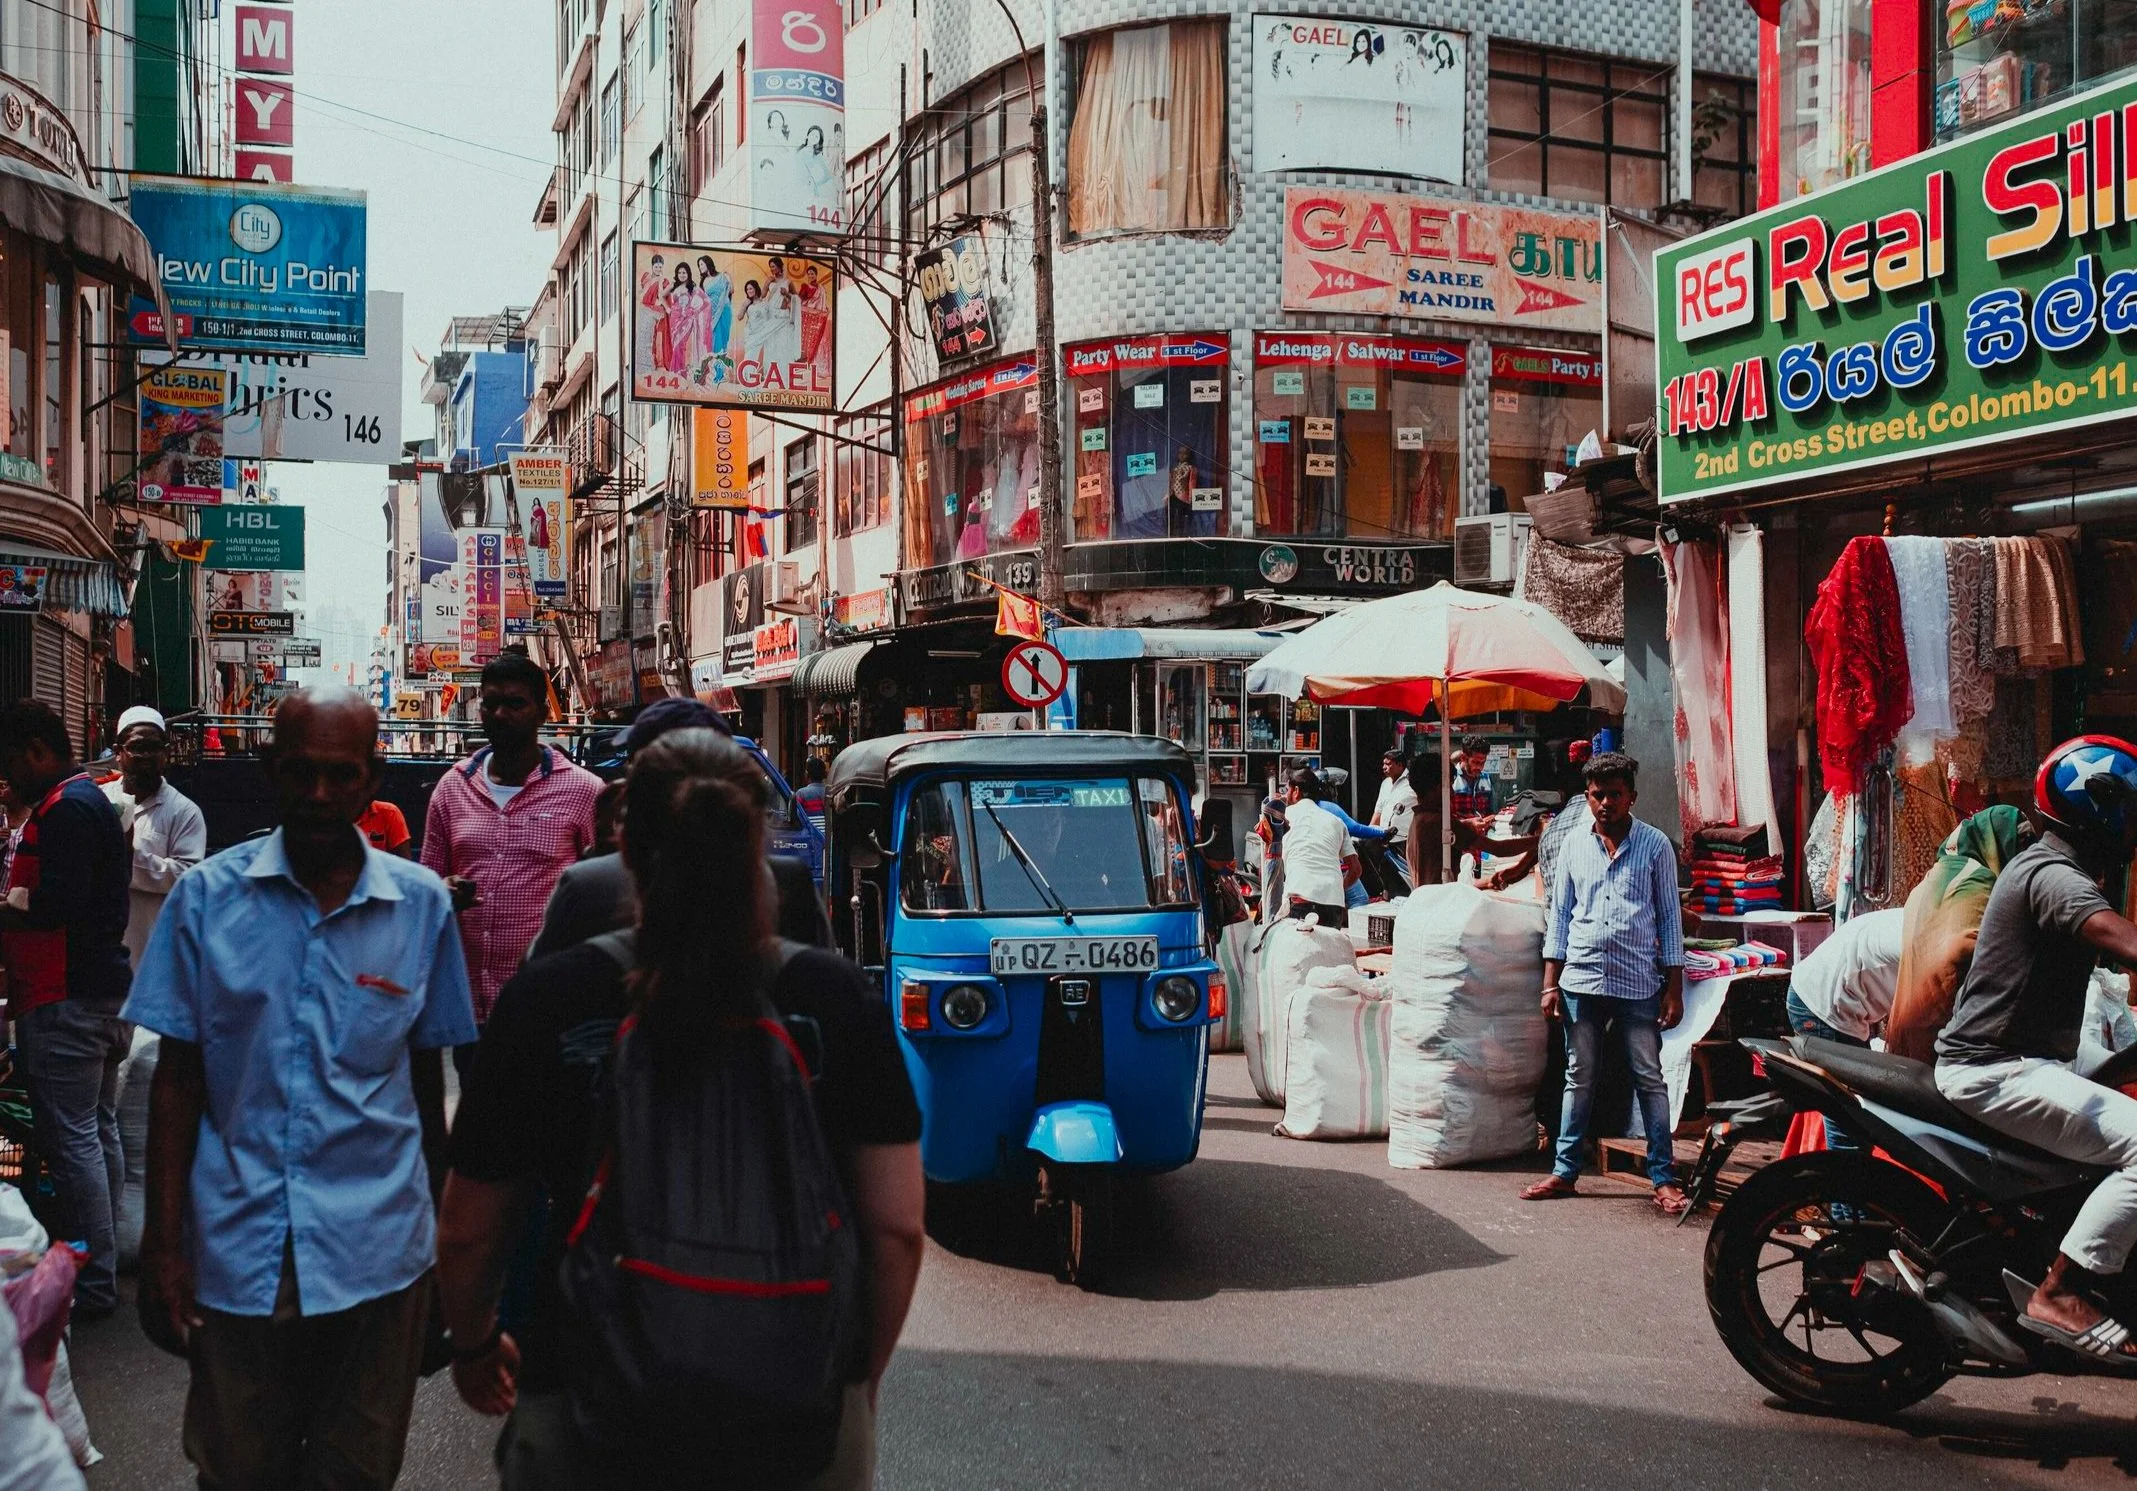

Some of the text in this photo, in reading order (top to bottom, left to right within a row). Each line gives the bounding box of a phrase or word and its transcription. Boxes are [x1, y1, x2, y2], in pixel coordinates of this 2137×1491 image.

[1293, 25, 1348, 47] GAEL
[807, 205, 841, 229] 144
[1769, 103, 2137, 323] Real Sil
[240, 211, 270, 240] City
[1291, 198, 1496, 265] GAEL
[220, 257, 278, 293] City
[287, 262, 361, 293] Point
[1324, 273, 1355, 290] 144
[1406, 268, 1484, 288] SAREE
[1528, 291, 1554, 307] 144
[1680, 250, 1748, 327] RES
[1399, 290, 1495, 312] MANDIR
[253, 327, 278, 338] CROSS
[1072, 348, 1110, 367] Party
[1114, 343, 1156, 360] Wear
[1184, 346, 1208, 355] Floor
[1259, 339, 1332, 361] Lehenga
[1348, 342, 1405, 361] Salwar
[1429, 353, 1447, 362] Floor
[737, 359, 829, 393] GAEL
[1551, 358, 1590, 379] Party
[644, 375, 680, 389] 144
[945, 383, 968, 401] Wedding
[148, 389, 219, 403] KING MARKETING
[230, 371, 333, 422] brics
[738, 391, 829, 408] SAREE MANDIR
[1663, 356, 1767, 437] 143/A
[344, 414, 381, 444] 146
[516, 459, 561, 469] AMBER
[1694, 446, 1738, 480] 2nd
[1748, 433, 1823, 469] Cross
[517, 469, 561, 477] TEXTILES
[226, 511, 280, 530] HBL
[226, 537, 280, 546] HABIB BANK
[1323, 547, 1415, 568] CENTRA
[483, 547, 493, 602] GUCCI
[1005, 561, 1033, 585] 139
[1335, 564, 1415, 585] WORLD
[254, 618, 290, 628] MOBILE
[398, 699, 420, 712] 79
[1075, 789, 1126, 803] TAXI
